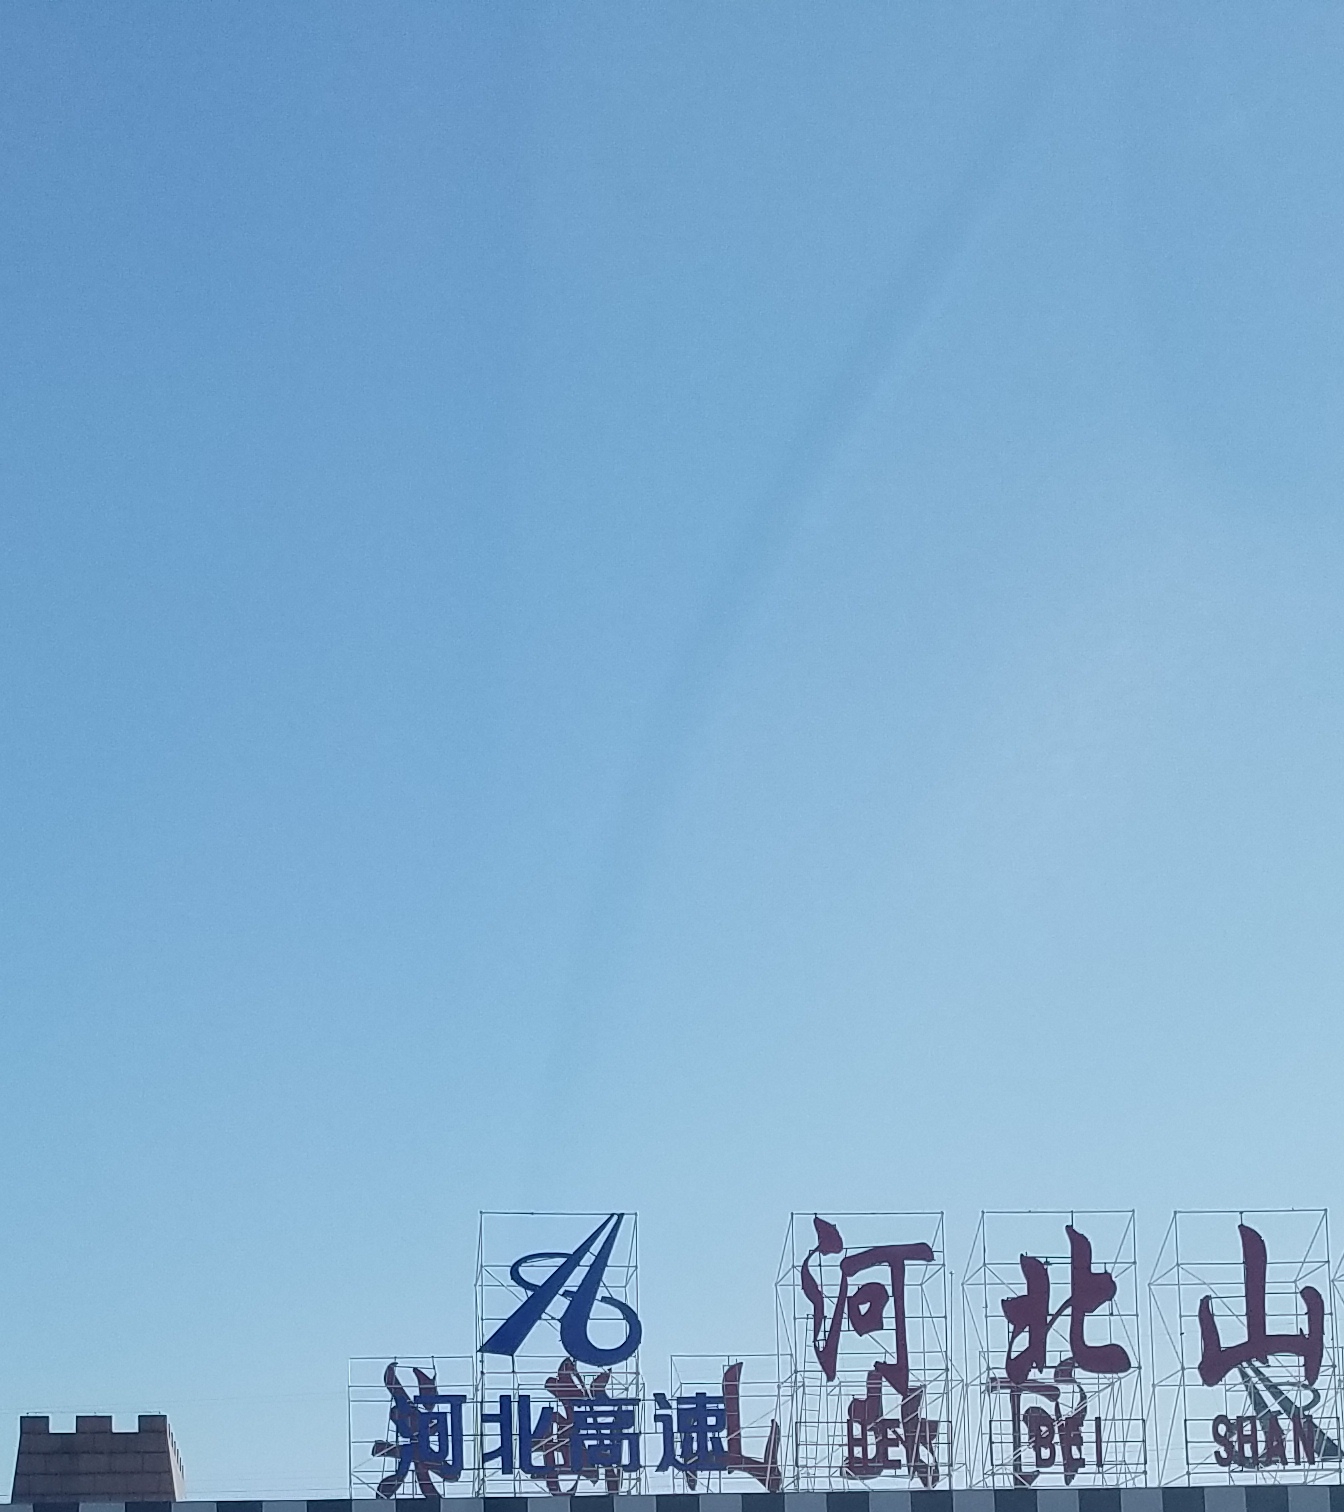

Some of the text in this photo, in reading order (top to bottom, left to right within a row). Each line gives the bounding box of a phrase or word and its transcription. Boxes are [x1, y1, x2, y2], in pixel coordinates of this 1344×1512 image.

[390, 1391, 728, 1475] 河北高速
[1035, 1417, 1104, 1469] BEI
[1212, 1414, 1315, 1468] SHAN
